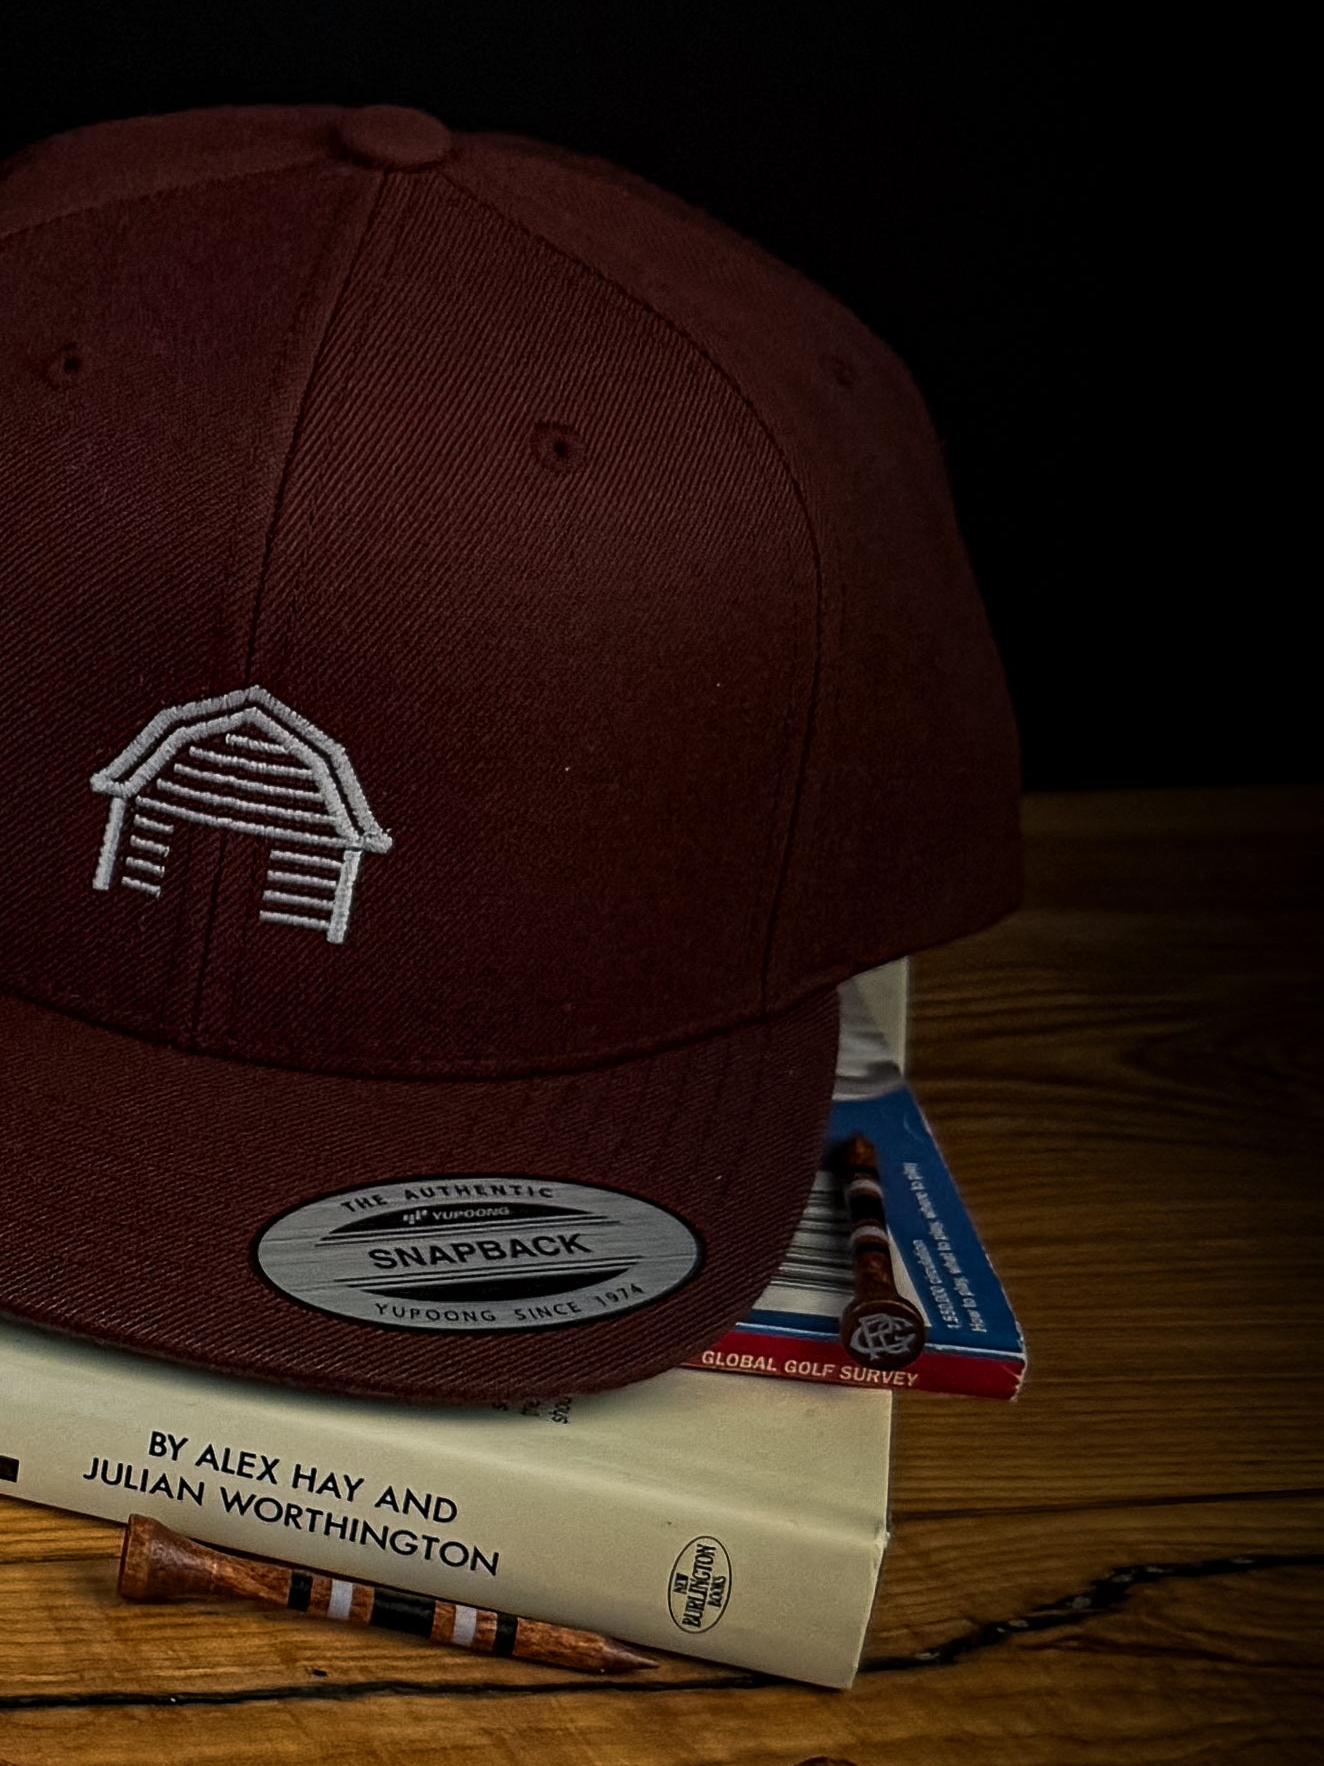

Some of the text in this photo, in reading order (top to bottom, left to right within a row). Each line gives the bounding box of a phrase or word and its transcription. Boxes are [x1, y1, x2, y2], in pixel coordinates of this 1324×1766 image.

[341, 1184, 555, 1214] THE AUTHENTIC
[431, 1205, 512, 1222] YUPOONG
[369, 1233, 592, 1270] SNAPBACK
[375, 1283, 645, 1323] YUPOONG SINCE 1974
[701, 1349, 919, 1387] GLOBAL GOLF SURVEY
[149, 1430, 458, 1524] BY ALEX HAY AND
[82, 1457, 500, 1577] JULIAN WORTHINGTON
[682, 1543, 716, 1628] BURLINGTON
